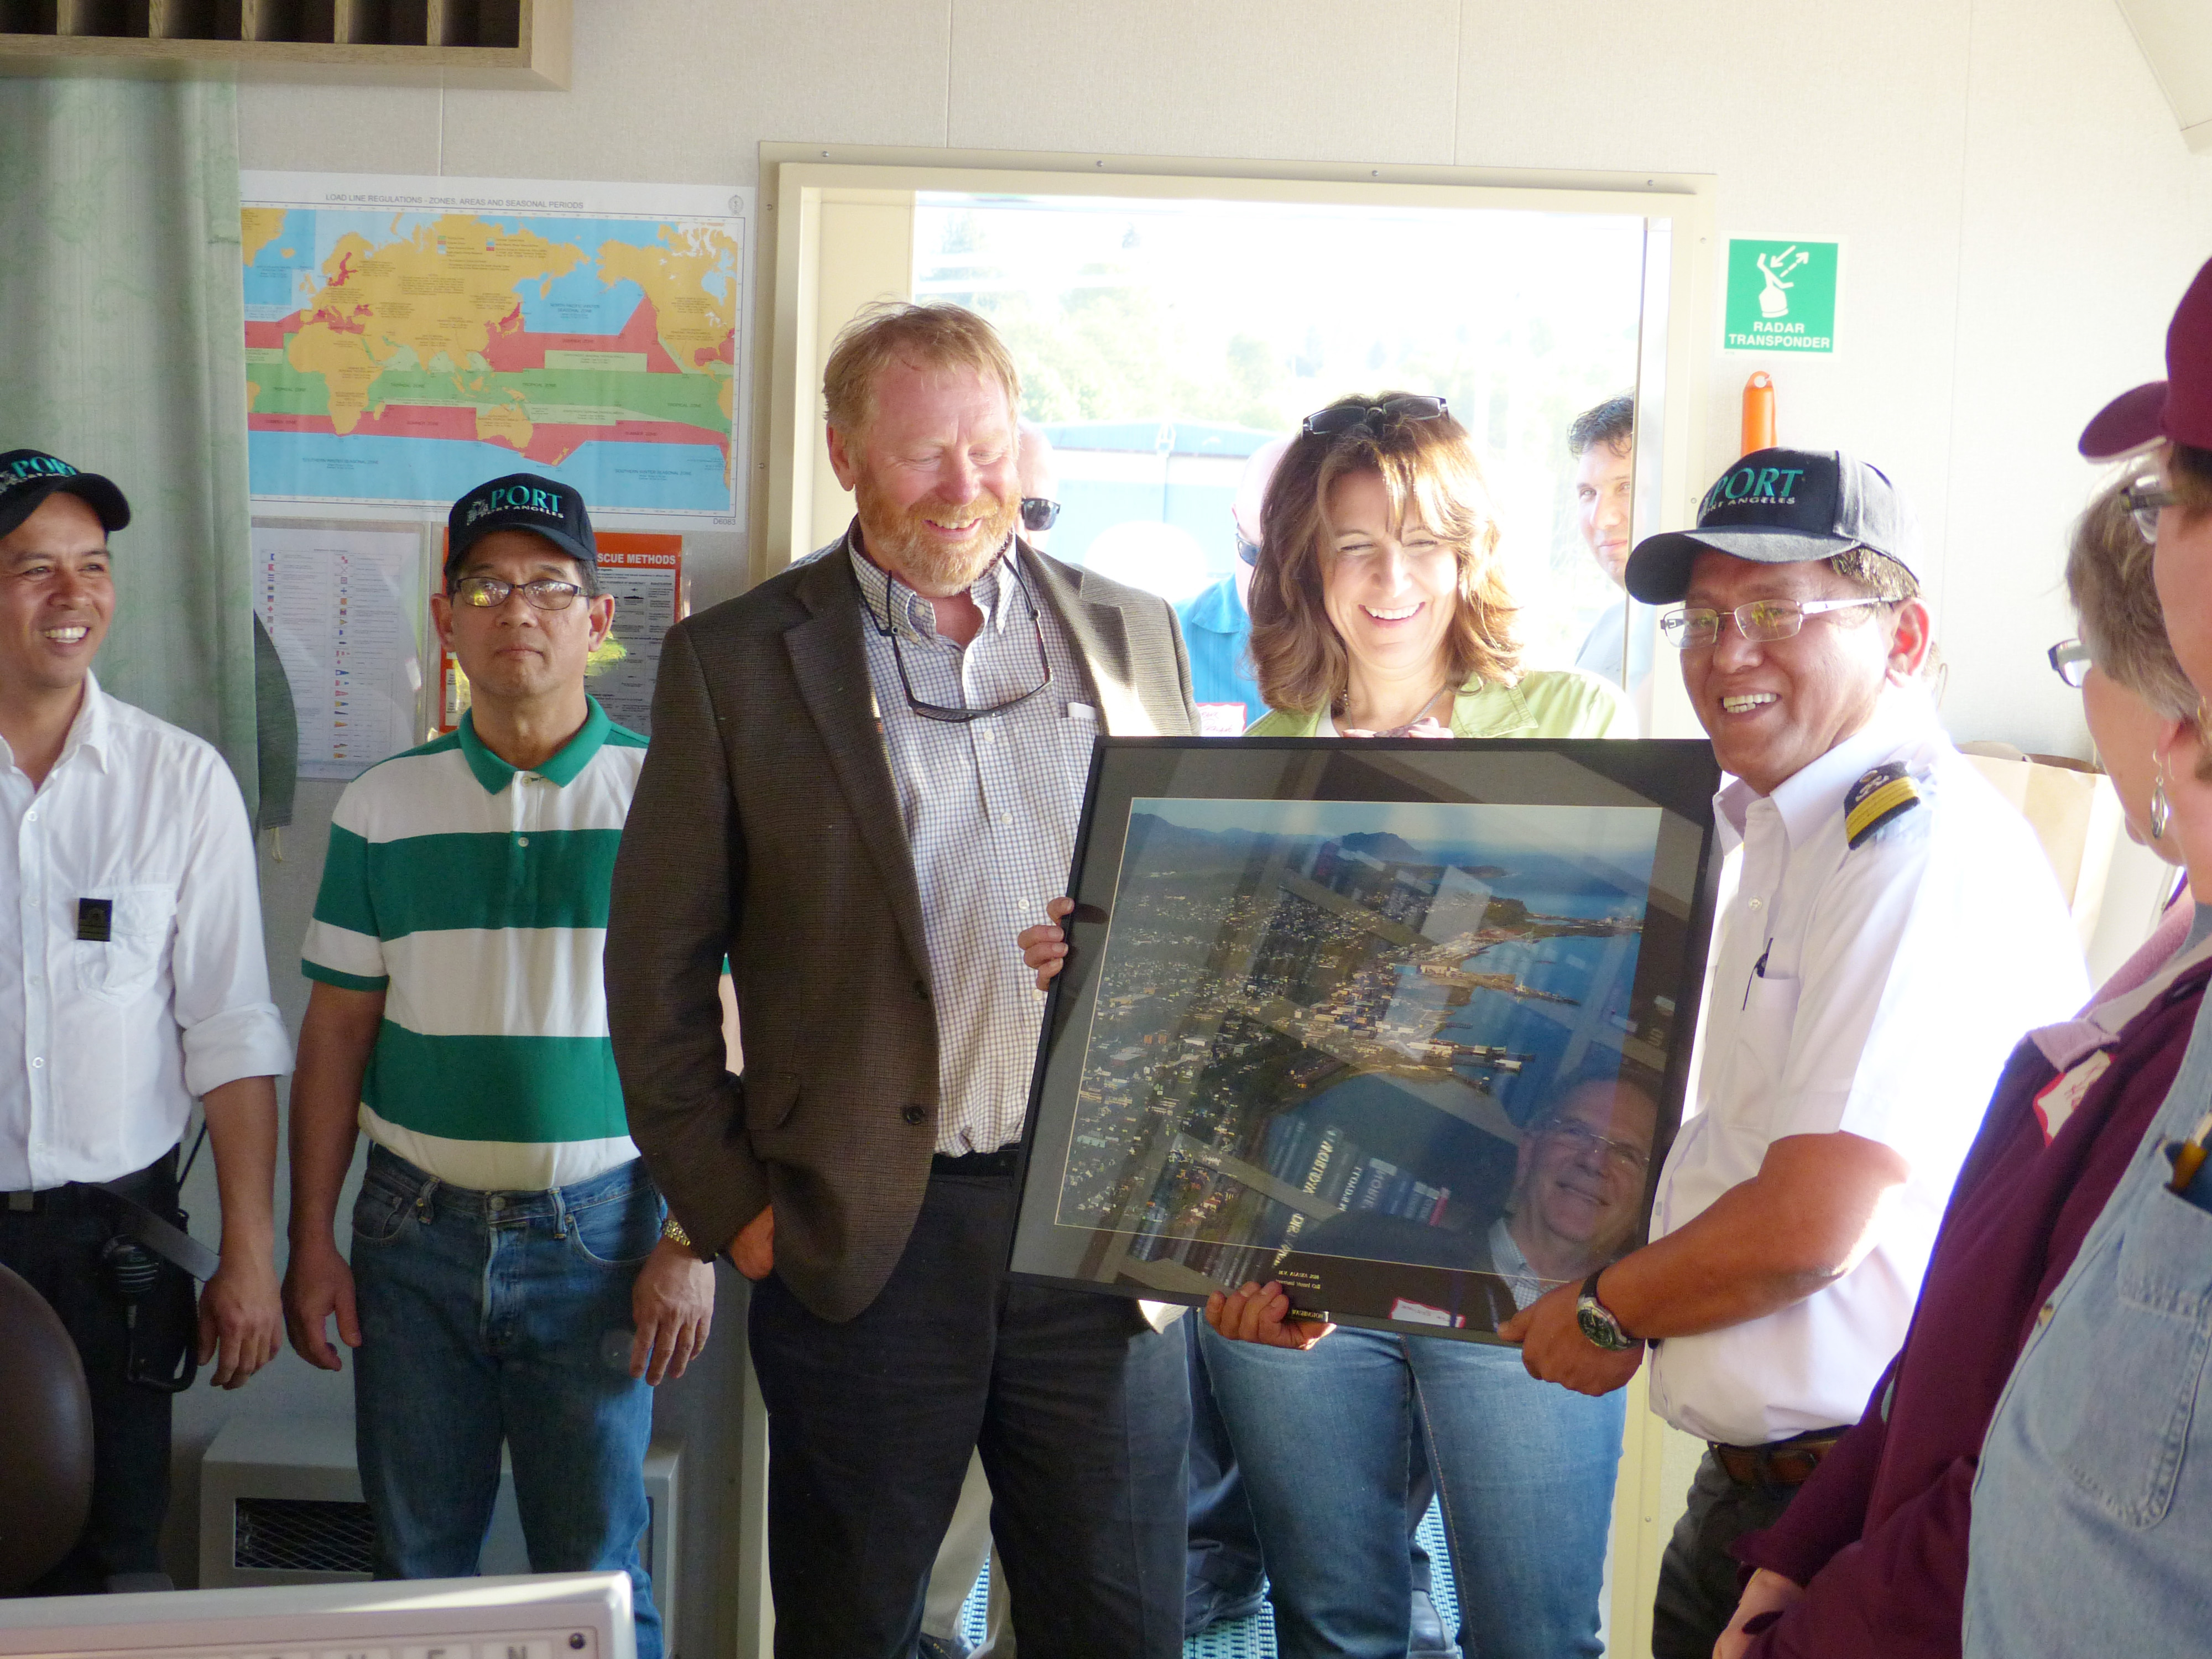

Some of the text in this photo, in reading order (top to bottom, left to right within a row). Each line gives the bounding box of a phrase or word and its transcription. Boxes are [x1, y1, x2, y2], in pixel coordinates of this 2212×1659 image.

[368, 195, 422, 204] REGULATIONS
[505, 200, 546, 208] SEASONAL
[549, 201, 584, 209] PERIODS
[1753, 321, 1805, 333] RADAR
[1728, 333, 1831, 349] TRANSPONDER
[1709, 467, 1804, 507] PORT
[491, 485, 563, 512] PORT
[1728, 497, 1797, 506] ANGELES
[513, 505, 565, 519] ANGELES
[597, 553, 676, 565] SCUE METHODS
